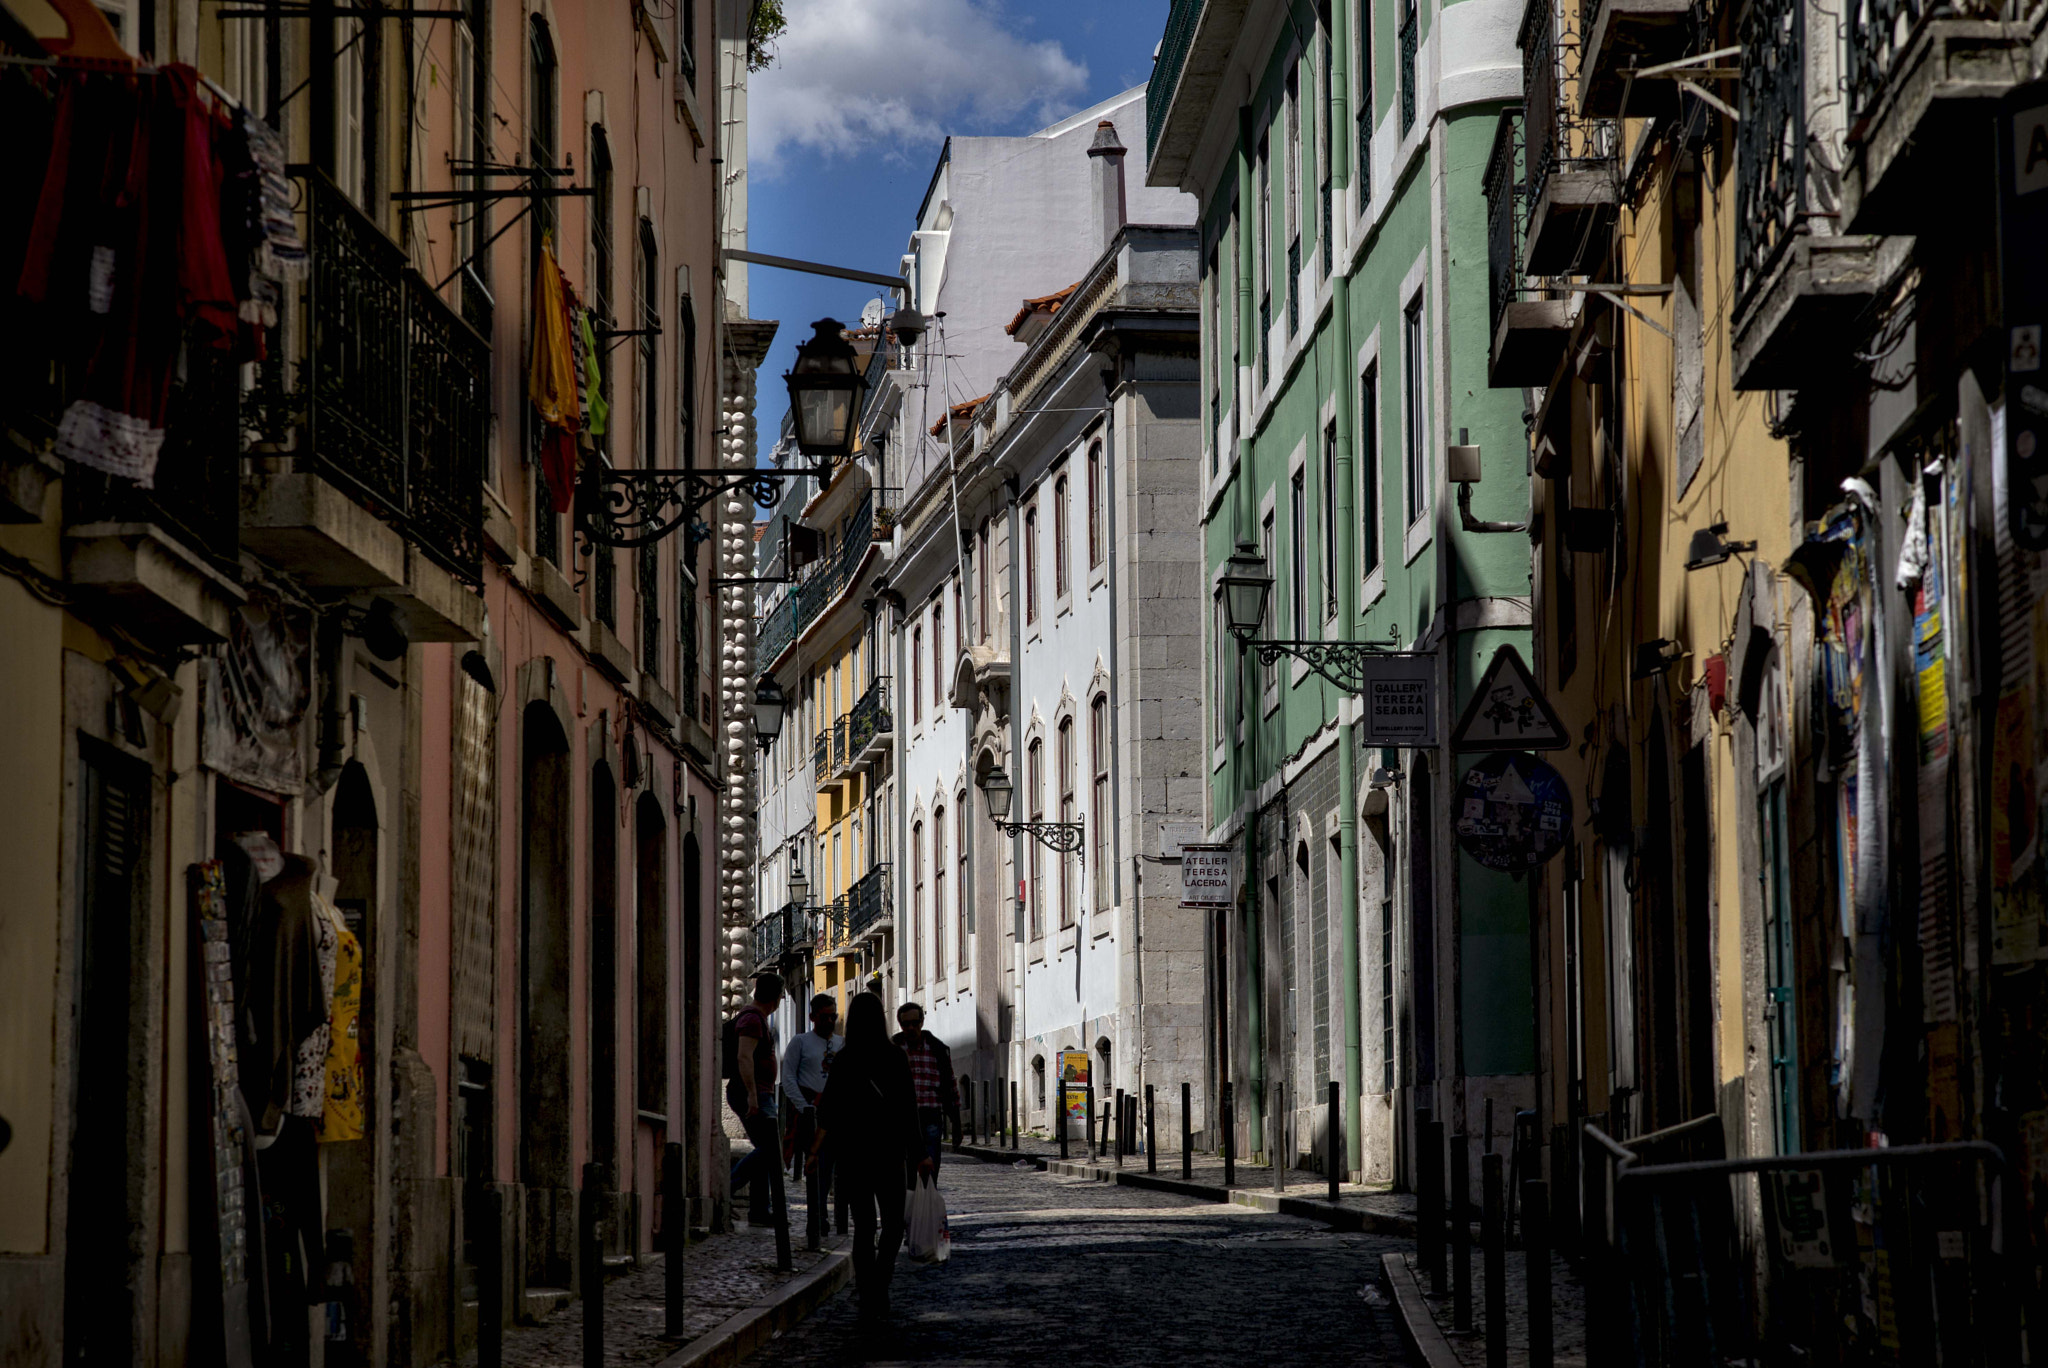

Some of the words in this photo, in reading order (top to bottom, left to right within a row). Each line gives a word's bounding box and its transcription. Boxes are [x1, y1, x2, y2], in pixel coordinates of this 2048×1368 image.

[1375, 684, 1423, 693] GALLERY
[1375, 695, 1423, 704] TEREZA
[1375, 706, 1424, 715] SEABRA
[1185, 857, 1228, 865] ATELIER
[1185, 868, 1228, 876] TERESA
[1185, 879, 1227, 887] LACERDA
